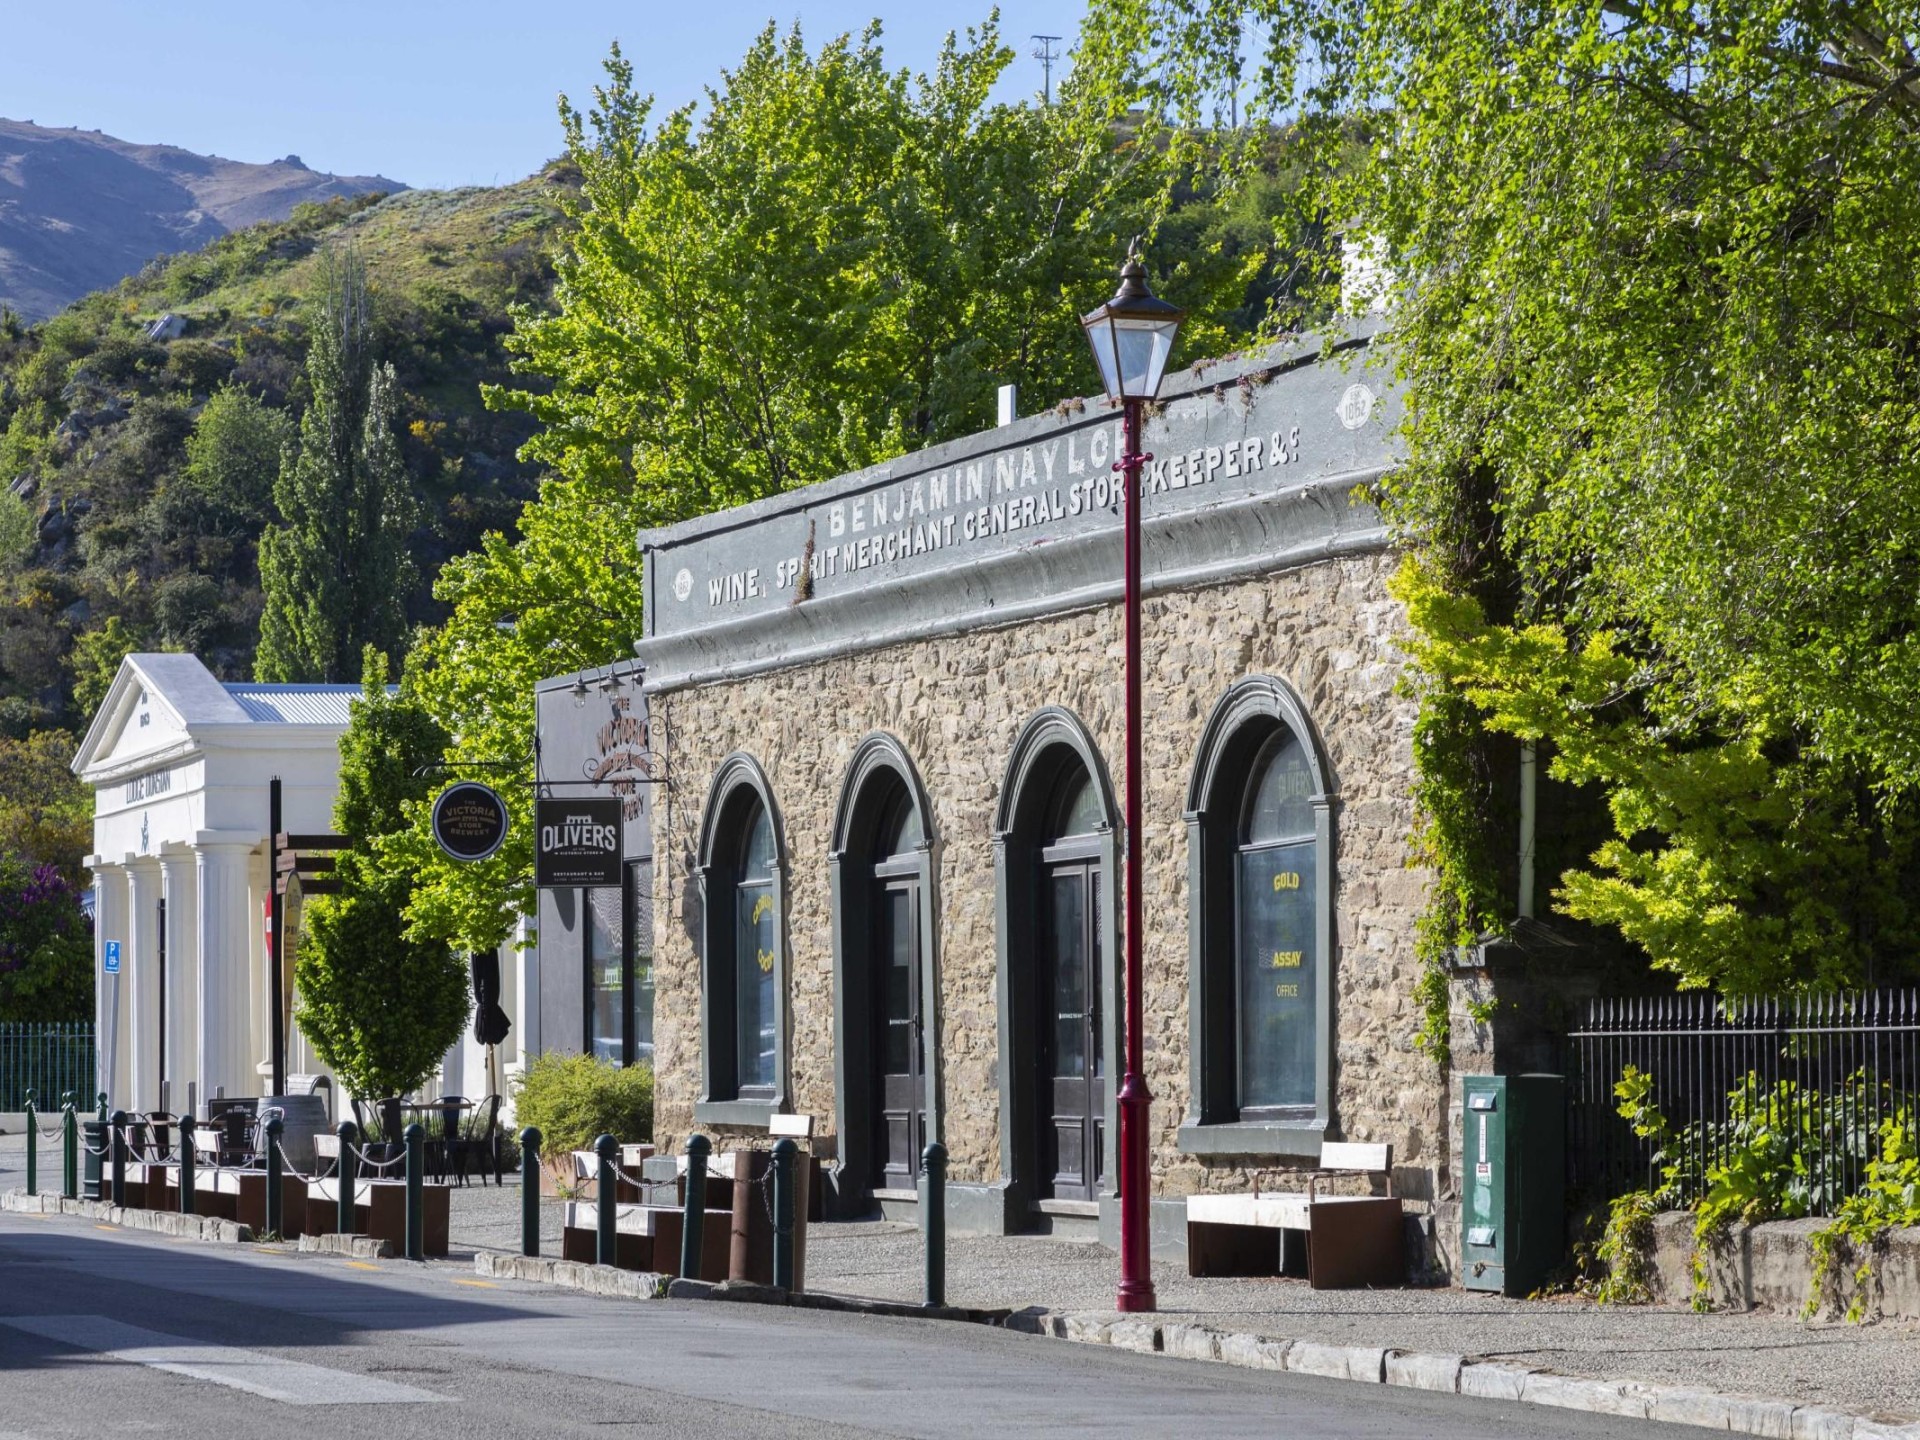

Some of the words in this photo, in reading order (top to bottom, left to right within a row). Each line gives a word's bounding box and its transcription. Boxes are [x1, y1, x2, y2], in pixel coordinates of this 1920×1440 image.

[1345, 400, 1367, 421] 1862
[829, 461, 984, 537] BENJAMIN
[963, 490, 1066, 541] GENERAL
[445, 806, 496, 818] VICTORIA
[450, 827, 490, 836] BREWERY
[542, 825, 616, 852] OLIVERS
[1273, 872, 1300, 891] GOLD
[110, 943, 116, 955] P
[1272, 951, 1302, 967] ASSAY
[1276, 984, 1298, 997] OFFICE
